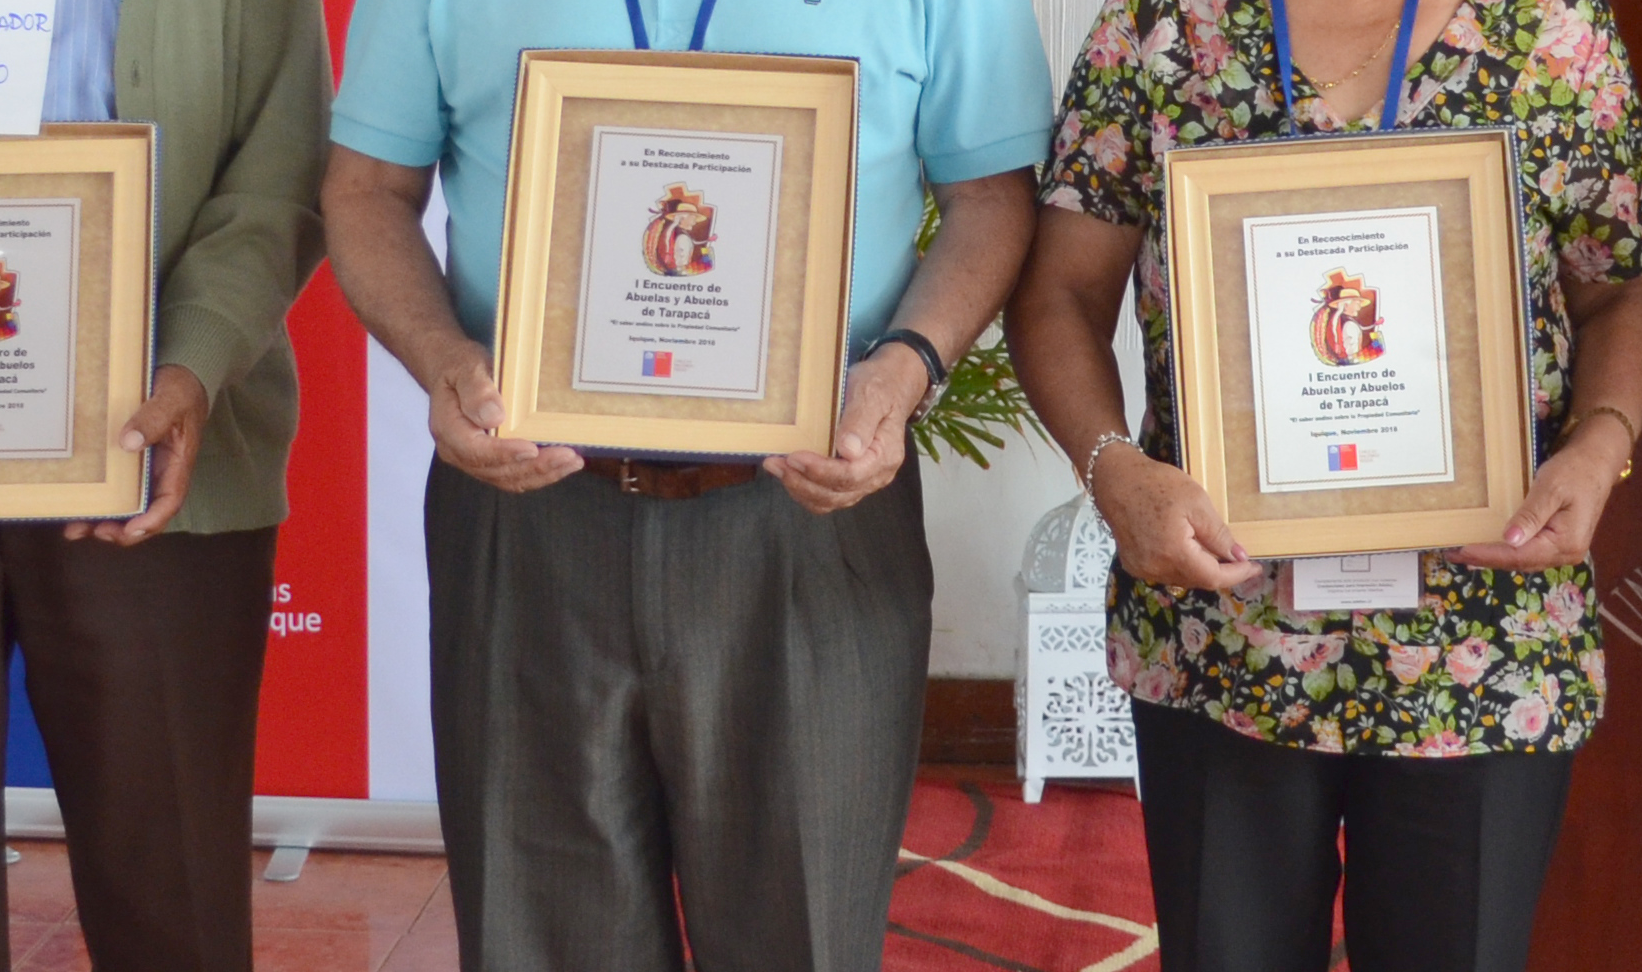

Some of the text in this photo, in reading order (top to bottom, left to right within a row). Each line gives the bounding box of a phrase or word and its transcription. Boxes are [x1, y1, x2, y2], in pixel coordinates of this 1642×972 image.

[658, 150, 730, 160] Reconocimiento
[643, 160, 689, 170] Destacada
[692, 163, 751, 173] Participación
[1298, 232, 1385, 245] En Reconocimiento
[1298, 247, 1345, 256] Destacada
[1349, 243, 1408, 253] Participación
[635, 279, 721, 293] I Encuentro de
[626, 292, 729, 306] Abuelas y Abuelos
[642, 308, 710, 320] de Tarapacá
[14, 348, 27, 357] de
[1308, 369, 1395, 382] I Encuentro de
[1302, 382, 1405, 396] Abuelas y Abuelos
[1320, 397, 1388, 410] de Tarapacá
[270, 612, 322, 637] que
